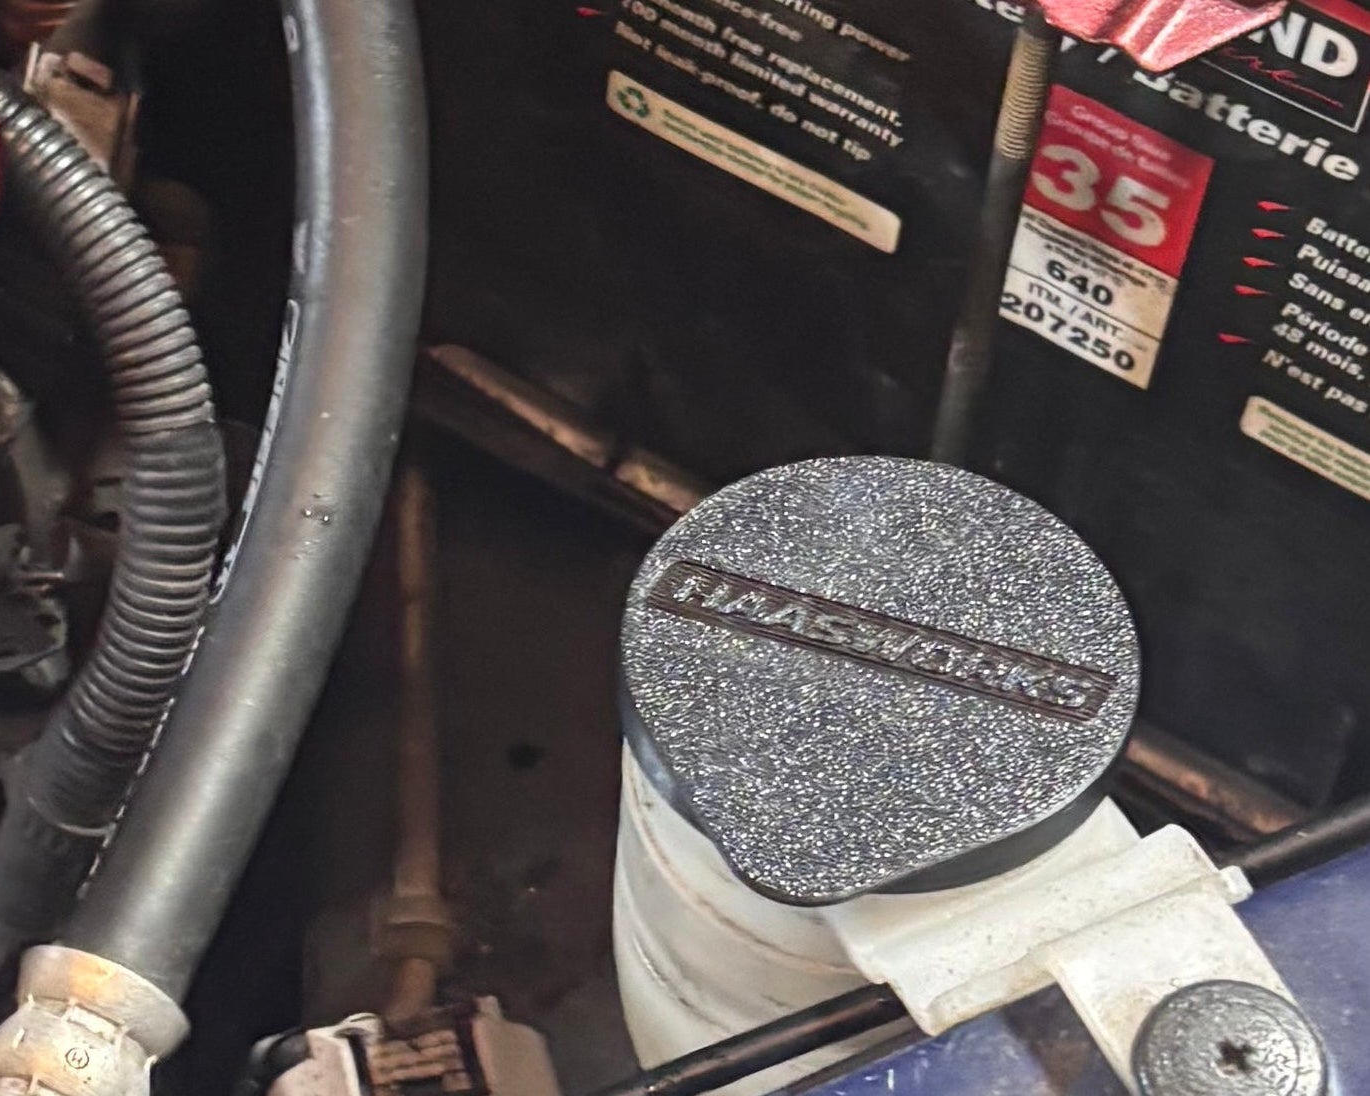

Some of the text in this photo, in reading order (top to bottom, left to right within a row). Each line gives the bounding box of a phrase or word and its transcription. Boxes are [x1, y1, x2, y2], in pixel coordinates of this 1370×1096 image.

[776, 0, 910, 61] rting power
[730, 51, 807, 97] limited
[808, 92, 904, 148] warranty
[770, 103, 798, 124] do
[801, 119, 838, 145] not
[842, 138, 872, 161] tip
[1032, 144, 1171, 247] 35
[1305, 216, 1370, 264] Batte
[1045, 258, 1114, 307] 640
[1288, 272, 1347, 311] Sans
[999, 291, 1136, 372] 207250
[1281, 302, 1369, 357] Période
[1324, 386, 1368, 414] pas
